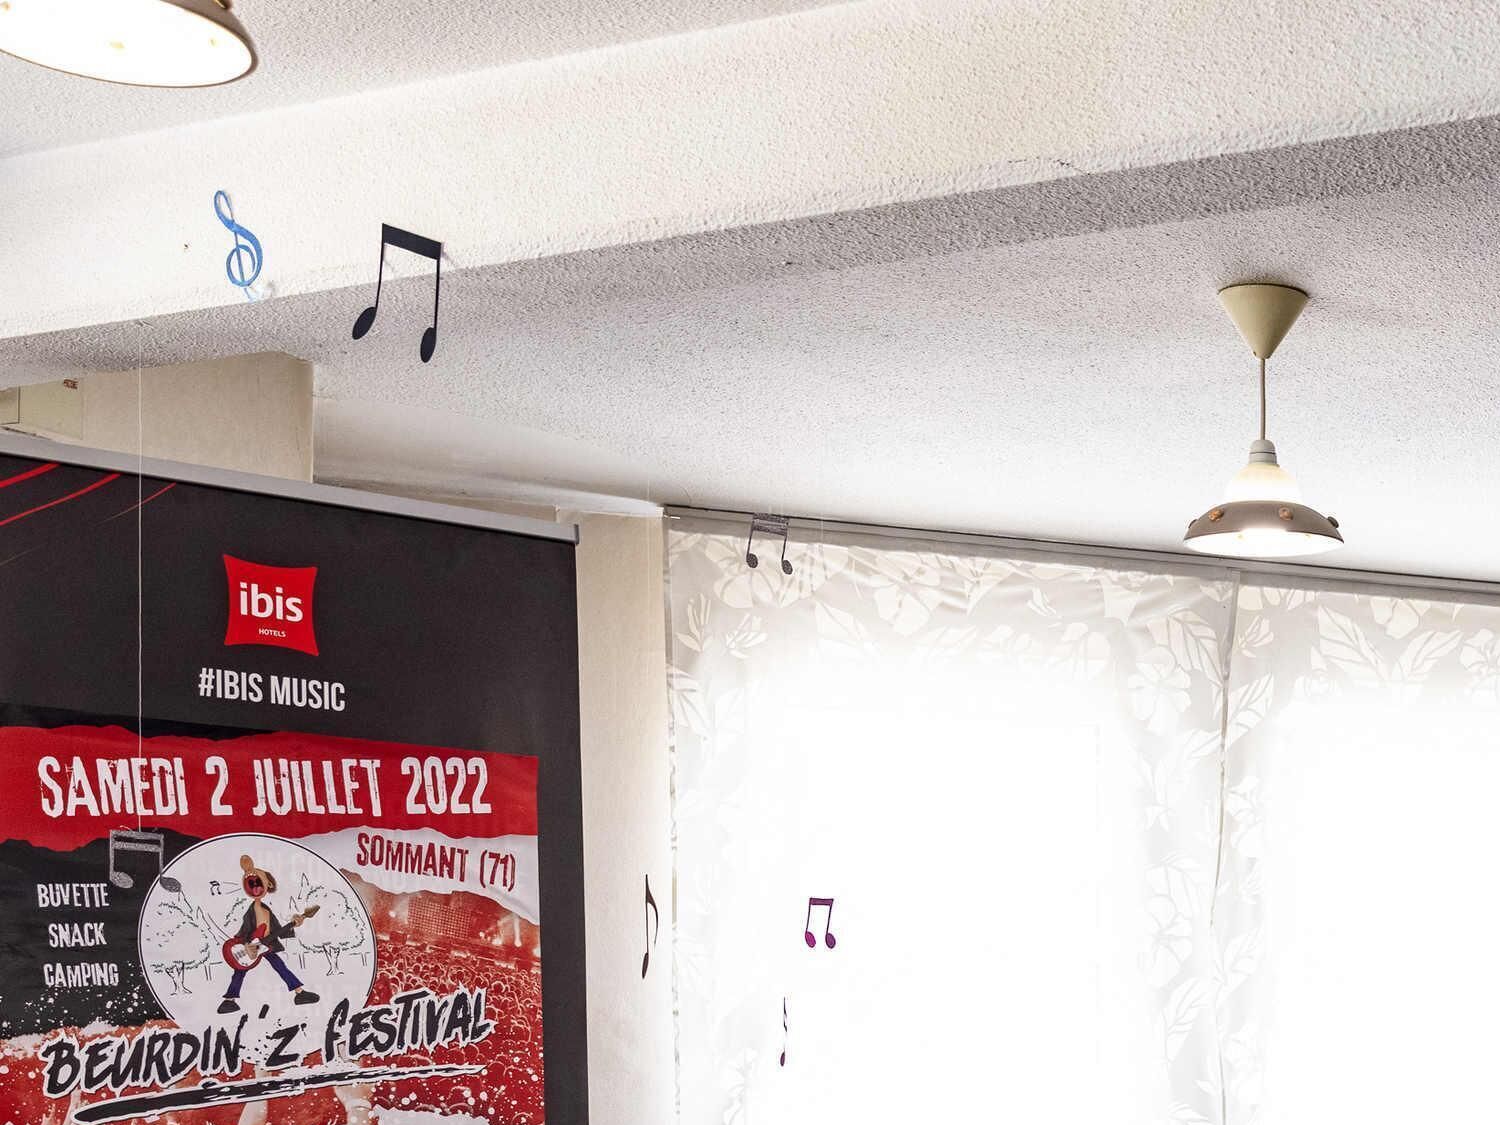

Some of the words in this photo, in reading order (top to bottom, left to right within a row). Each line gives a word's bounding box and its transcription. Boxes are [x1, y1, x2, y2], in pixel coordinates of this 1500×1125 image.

[240, 581, 303, 622] ibis
[258, 628, 286, 637] HOTELS
[198, 667, 263, 703] #IBIS
[270, 675, 346, 712] MUSIC
[37, 756, 190, 817] SAMEDI
[205, 756, 231, 816] 2
[252, 758, 382, 817] JUILLET
[400, 756, 493, 815] 2022
[357, 832, 469, 882] SOMMANT
[479, 849, 517, 892] (71)
[36, 882, 110, 909] BUVETTE
[48, 922, 107, 948] SNACK
[43, 962, 120, 988] CAMPING
[325, 990, 492, 1063] FESTIVAL
